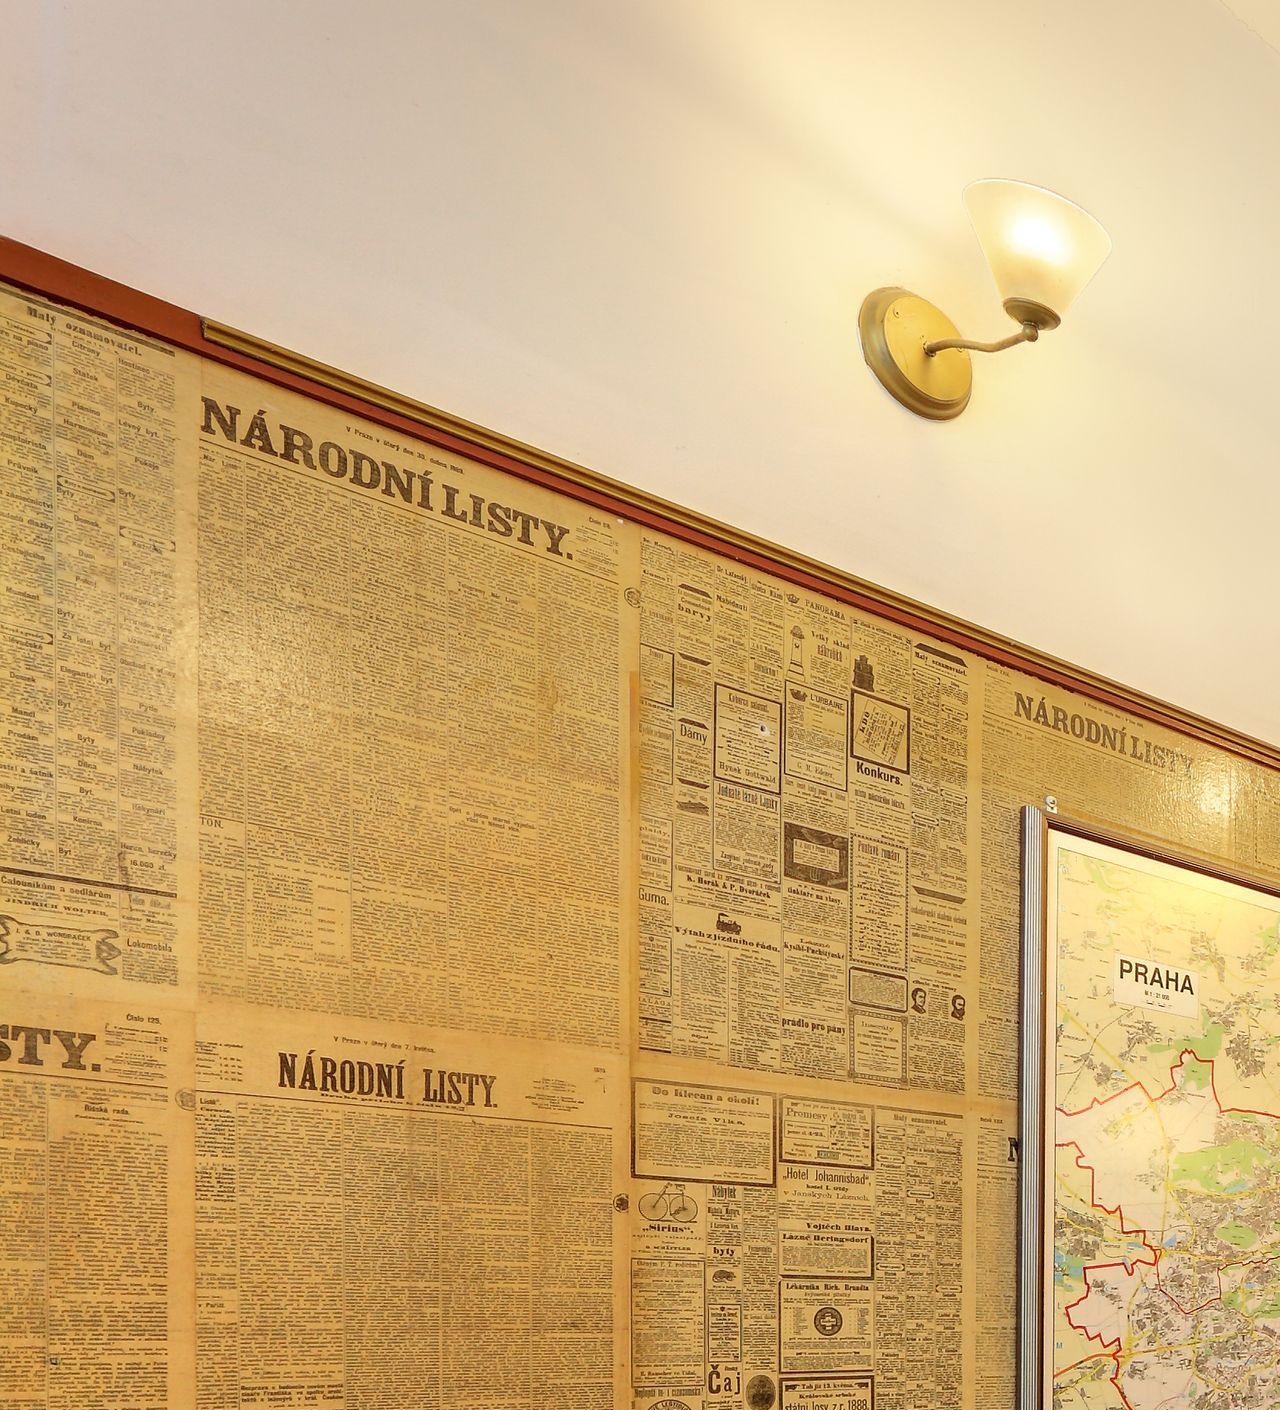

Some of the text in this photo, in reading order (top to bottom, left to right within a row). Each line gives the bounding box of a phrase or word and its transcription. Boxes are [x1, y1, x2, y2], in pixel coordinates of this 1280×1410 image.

[200, 396, 574, 561] NÁRODNÍ LISTY.
[680, 724, 708, 745] Dámy
[1014, 691, 1127, 755] NÁRODNÍ
[856, 761, 903, 787] Konkurs.
[638, 887, 670, 907] Guma.
[1119, 958, 1194, 996] PRAHA
[277, 1049, 498, 1108] NÁRODNÍ LISTY.
[713, 1246, 736, 1257] byty
[708, 1364, 741, 1395] Čaj
